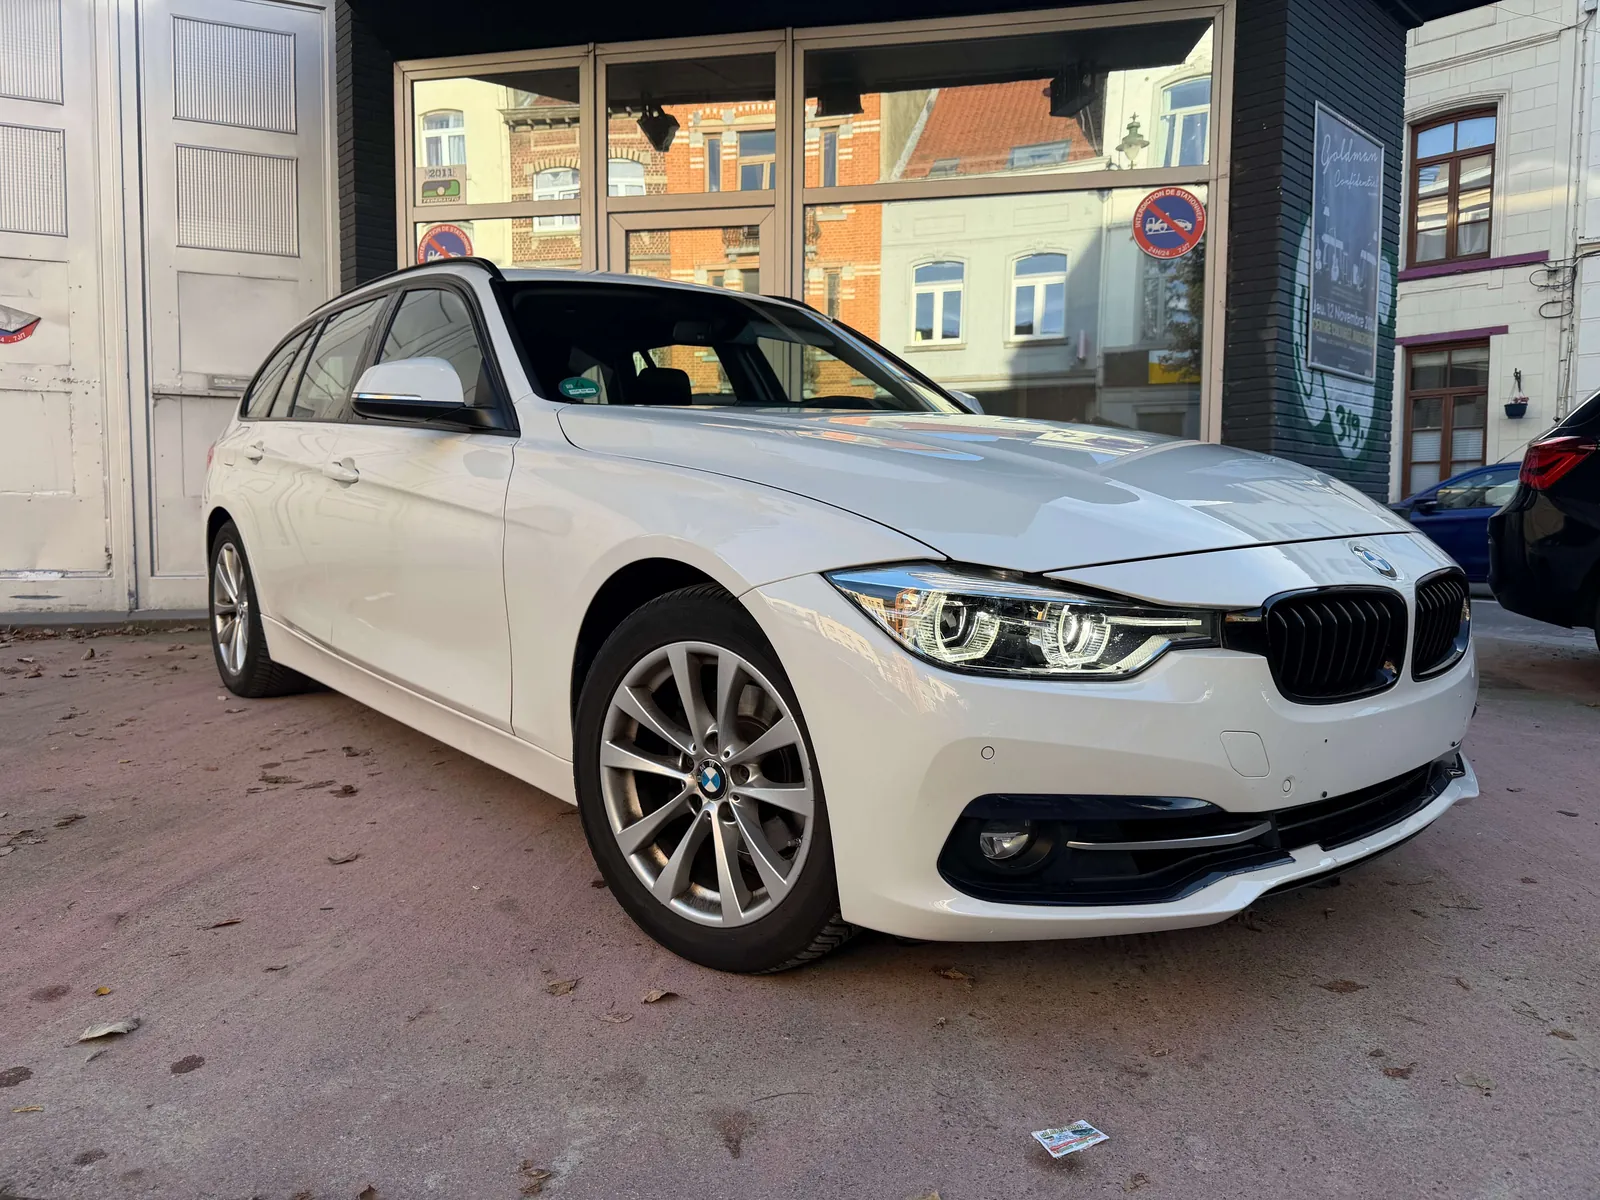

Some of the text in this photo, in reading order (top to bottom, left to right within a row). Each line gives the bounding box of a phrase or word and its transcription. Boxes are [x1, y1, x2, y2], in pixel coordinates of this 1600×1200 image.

[1320, 133, 1378, 175] Goldman
[429, 168, 453, 178] 2011
[1135, 188, 1203, 228] INTERDICTION DE STATIONNER
[418, 224, 472, 260] INTERDICTION DE STATIONNER
[1148, 242, 1190, 256] 24H/24 7J/7
[1327, 302, 1335, 319] 12
[1335, 304, 1365, 328] Novembre
